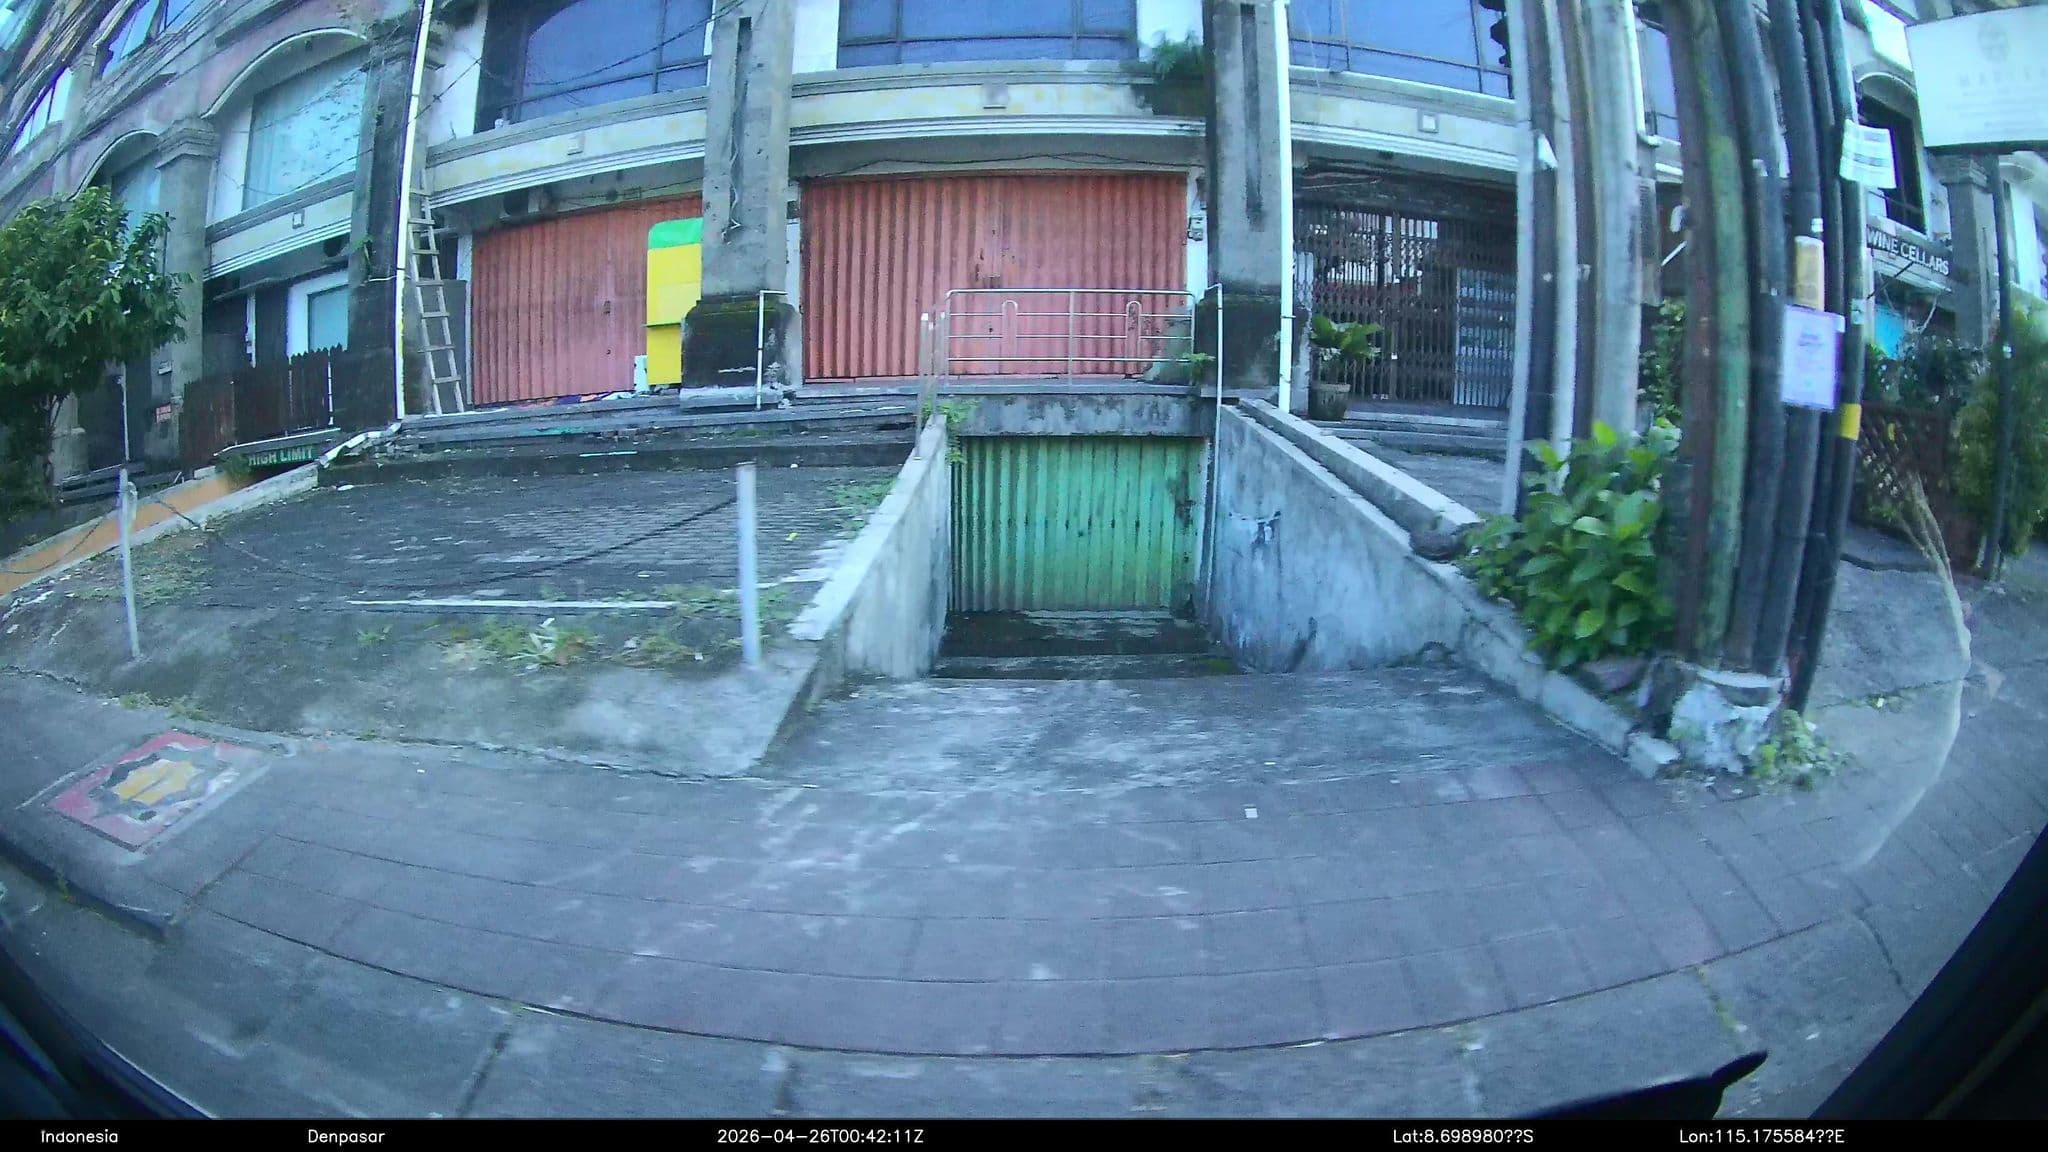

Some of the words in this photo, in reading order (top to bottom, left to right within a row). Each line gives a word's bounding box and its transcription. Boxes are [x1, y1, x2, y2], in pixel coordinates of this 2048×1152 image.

[1866, 228, 1899, 254] WINE
[1900, 242, 1949, 276] CELLARS
[248, 451, 277, 466] HIGH
[280, 446, 313, 462] LIMIT
